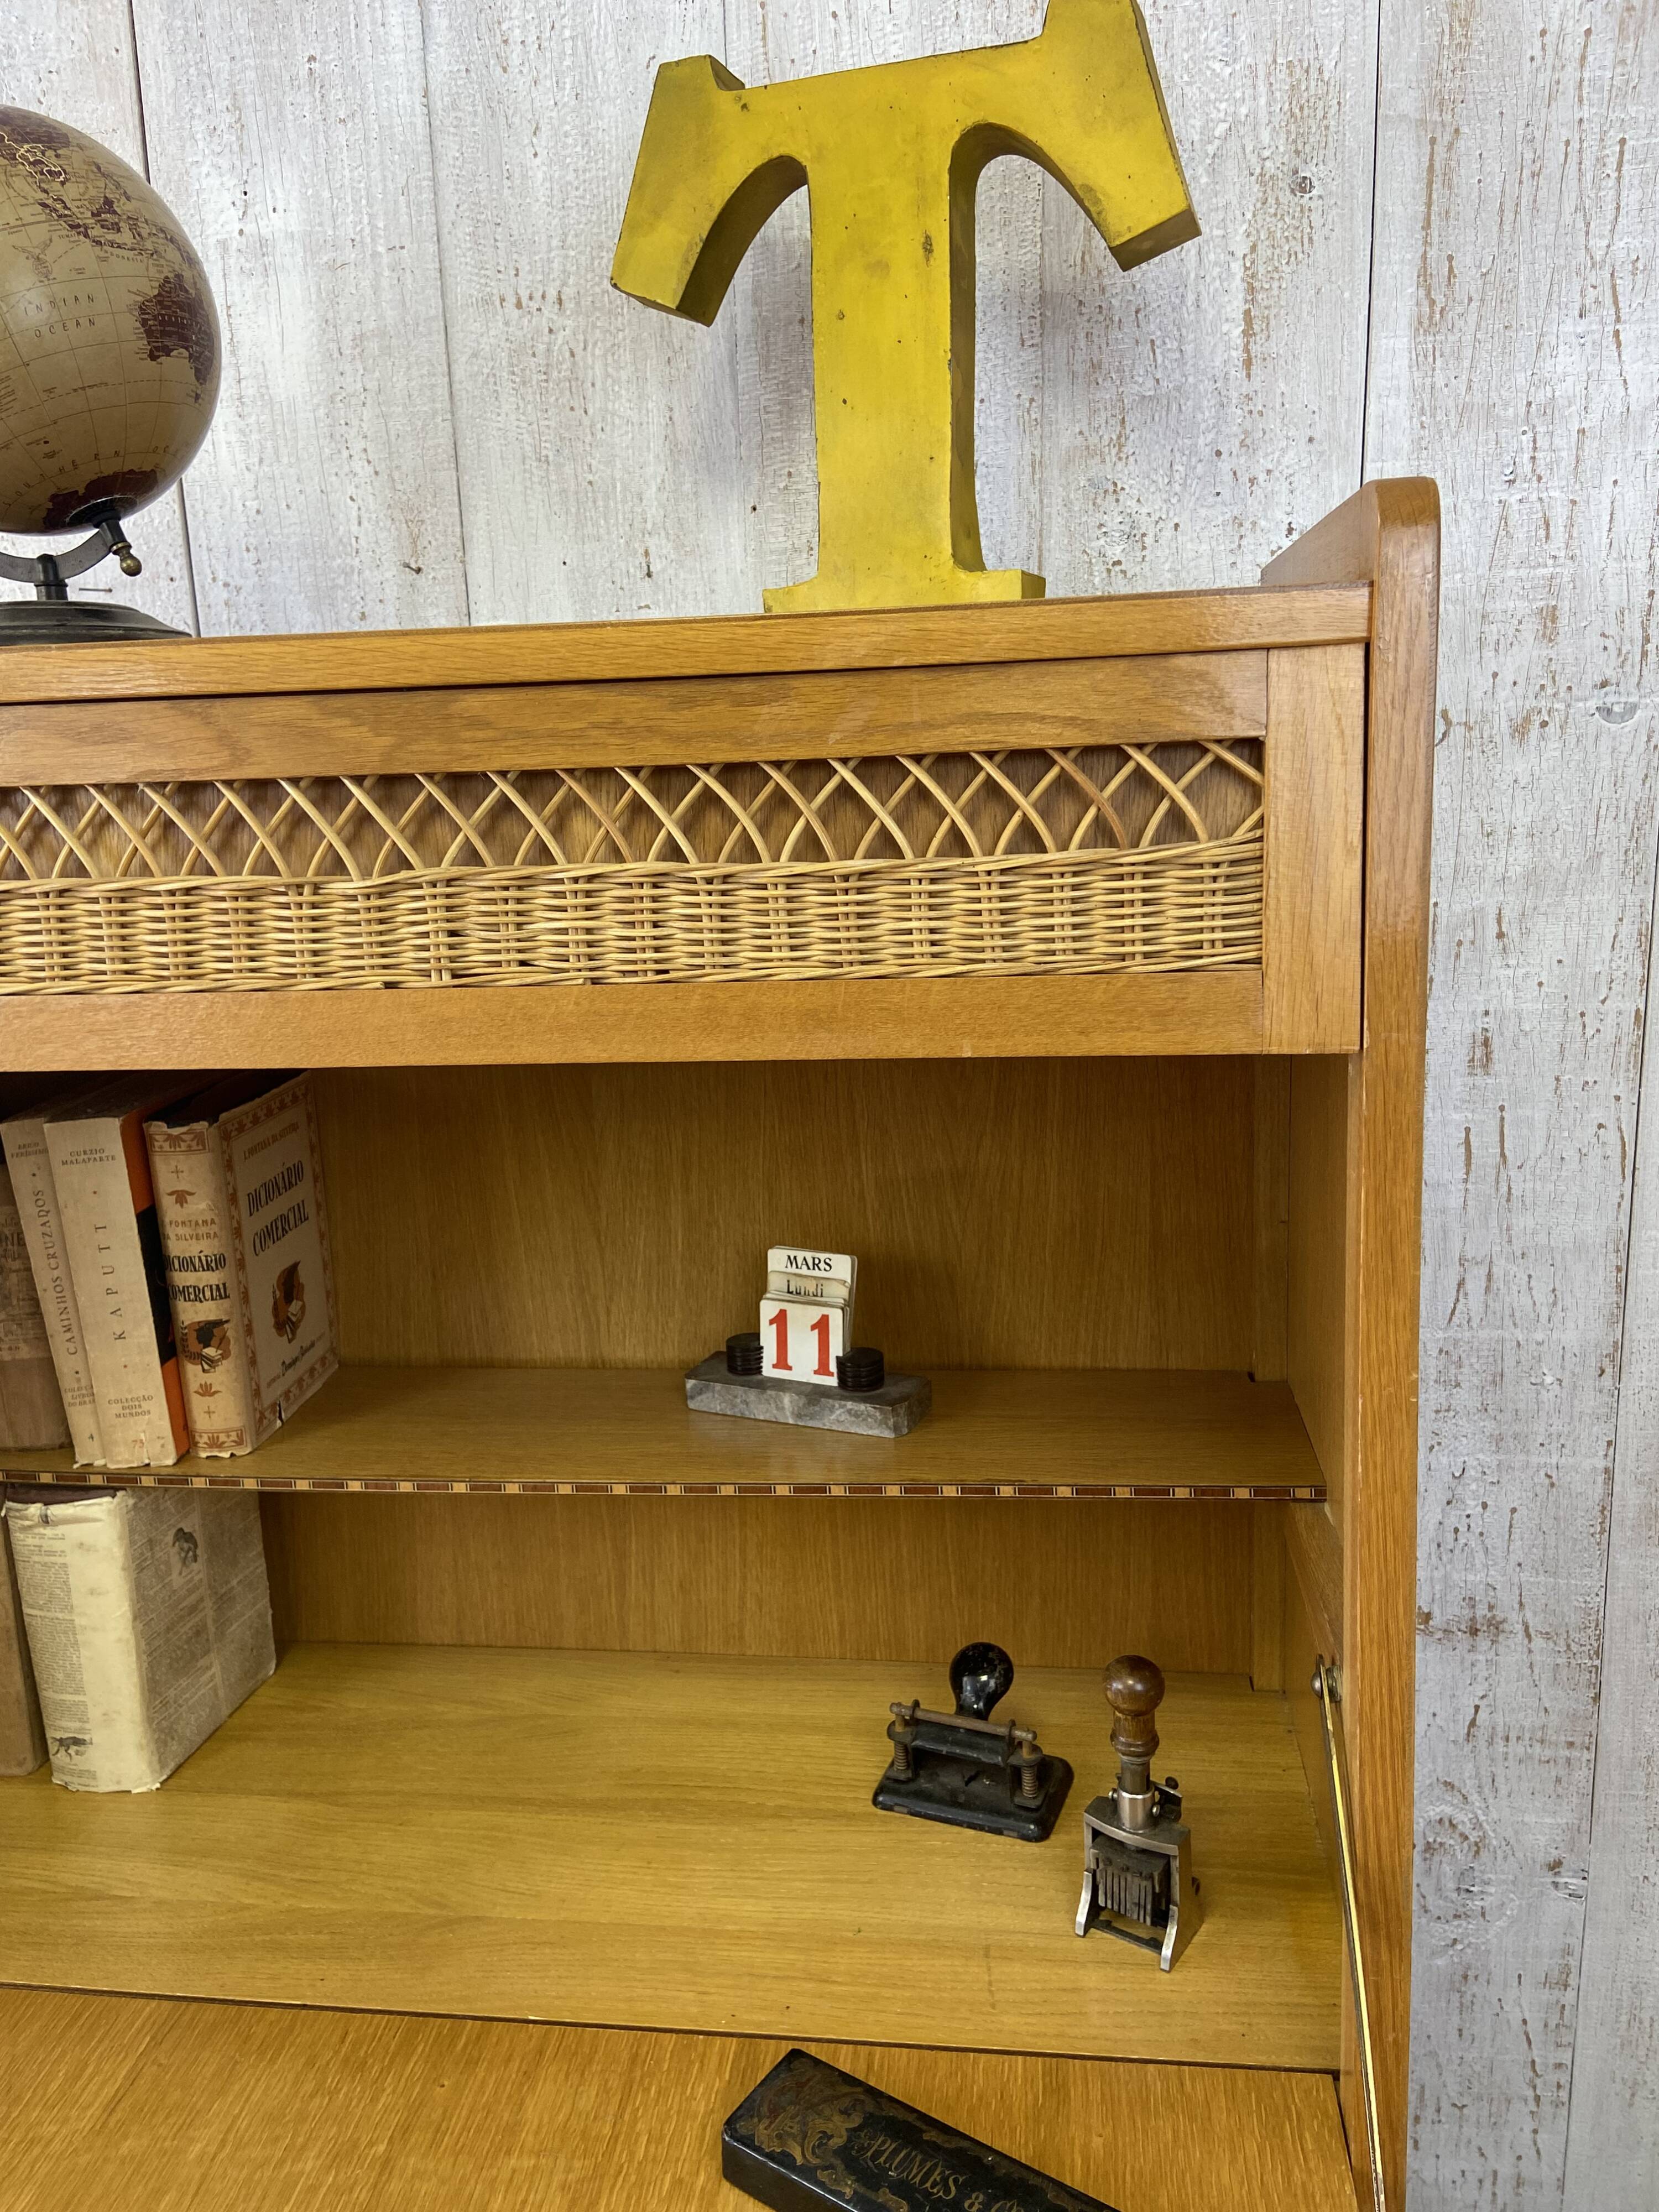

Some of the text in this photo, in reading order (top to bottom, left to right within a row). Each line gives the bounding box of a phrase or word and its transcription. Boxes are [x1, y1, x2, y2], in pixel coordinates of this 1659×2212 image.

[24, 293, 95, 315] INDIAN
[611, 0, 1199, 614] T
[35, 317, 96, 338] OCEAN
[61, 1155, 116, 1166] MALAPARTE
[70, 1148, 105, 1157] CURZIO
[247, 1160, 304, 1217] DICIONÁRIO
[169, 1218, 217, 1228] FONTANA
[253, 1198, 309, 1257] COMERCIAL
[175, 1231, 219, 1241] SILVEIRA
[33, 1190, 77, 1355] CAMINHOS CRUZADOS
[784, 1254, 832, 1272] MARS
[94, 1224, 127, 1340] KAPUTT
[768, 1308, 835, 1378] 11
[108, 1395, 154, 1405] COLECÇÃO
[114, 1410, 151, 1419] MUNDOS
[852, 2130, 971, 2200] PLUMES
